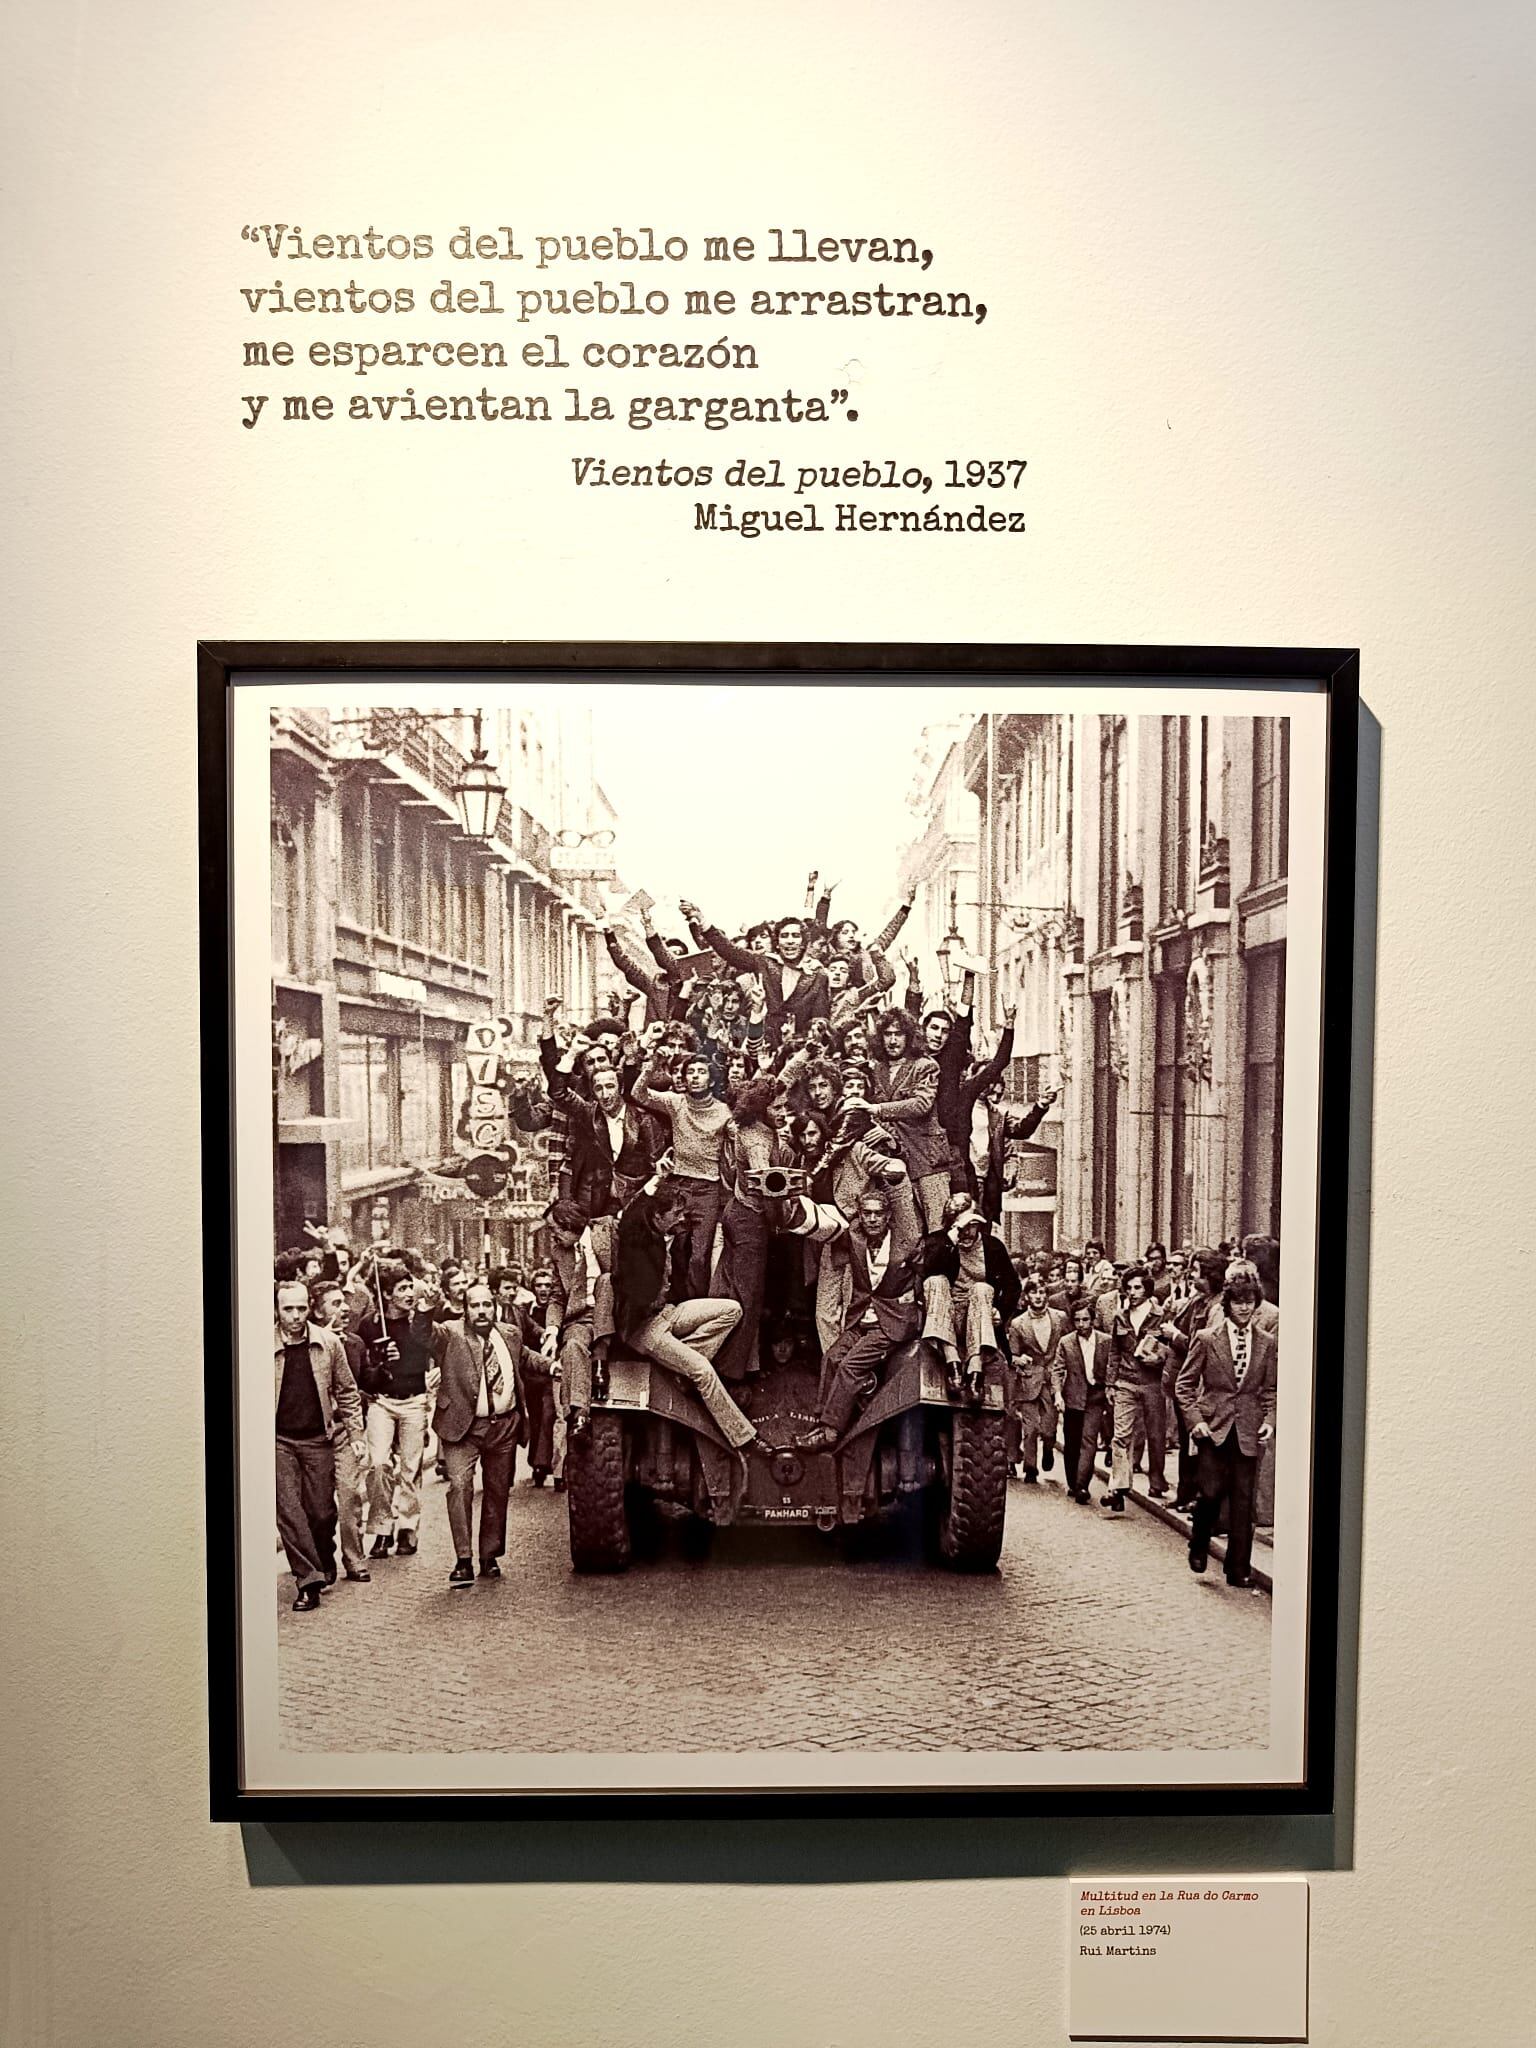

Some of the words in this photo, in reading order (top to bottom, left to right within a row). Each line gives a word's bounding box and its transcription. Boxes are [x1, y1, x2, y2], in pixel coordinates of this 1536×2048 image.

[241, 224, 433, 260] “Vientos
[449, 226, 523, 260] del
[536, 228, 688, 269] pueblo
[704, 237, 754, 261] me
[768, 229, 934, 271] llevan,
[240, 280, 415, 313] vientos
[430, 280, 504, 313] del
[516, 281, 669, 322] pueblo
[684, 290, 735, 315] me
[751, 283, 988, 325] arrastran,
[243, 342, 294, 366] me
[309, 342, 508, 375] esparcen
[522, 335, 569, 368] el
[583, 336, 759, 369] corazón
[241, 396, 269, 430] y
[283, 396, 334, 420] me
[349, 387, 552, 421] avientan
[565, 389, 615, 421] la
[628, 389, 859, 430] garganta”.
[572, 457, 713, 487] Vientos
[725, 459, 785, 487] del
[794, 460, 932, 494] pueblo,
[945, 460, 1027, 489] 1937
[694, 503, 824, 538] Miguel
[835, 503, 1026, 533] Hernández
[764, 1509, 809, 1519] PANHARD
[1080, 1890, 1139, 1901] Multitud
[1141, 1892, 1156, 1901] en
[1159, 1891, 1174, 1901] la
[1177, 1890, 1200, 1901] Rua
[1203, 1890, 1219, 1901] do
[1221, 1890, 1259, 1901] Carmo
[1080, 1907, 1095, 1916] en
[1098, 1905, 1141, 1916] Lisboa
[1079, 1925, 1097, 1936] (25
[1100, 1925, 1136, 1936] abril
[1139, 1924, 1171, 1936] 1974)
[1079, 1945, 1103, 1956] Rui
[1106, 1945, 1157, 1956] Martins
